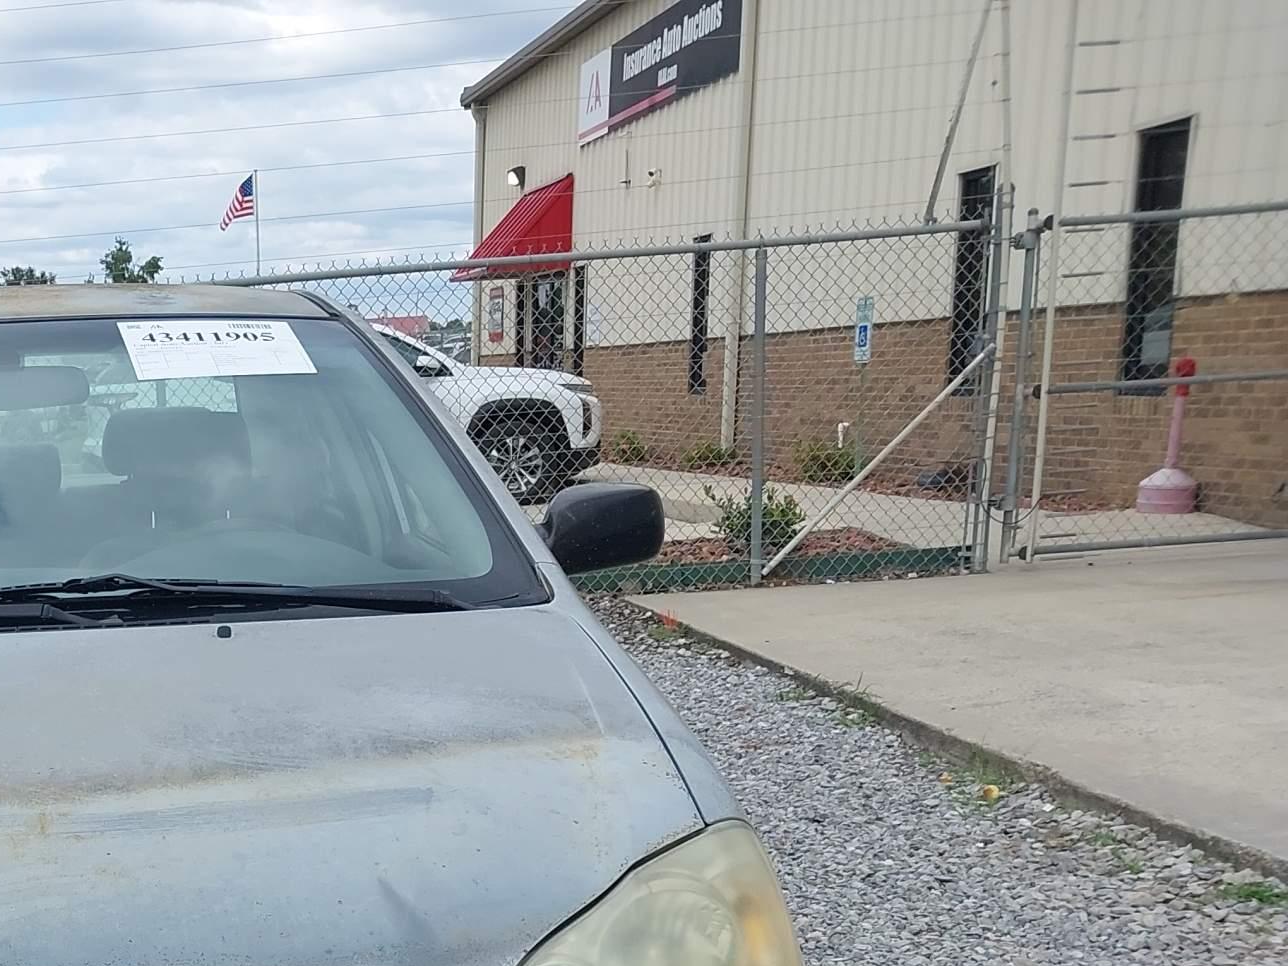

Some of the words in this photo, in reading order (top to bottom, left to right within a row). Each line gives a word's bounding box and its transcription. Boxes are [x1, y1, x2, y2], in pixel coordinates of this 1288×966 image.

[623, 37, 661, 82] Insurance
[662, 24, 682, 60] Auto
[682, 0, 723, 48] Auctions
[141, 331, 277, 344] 43411905
